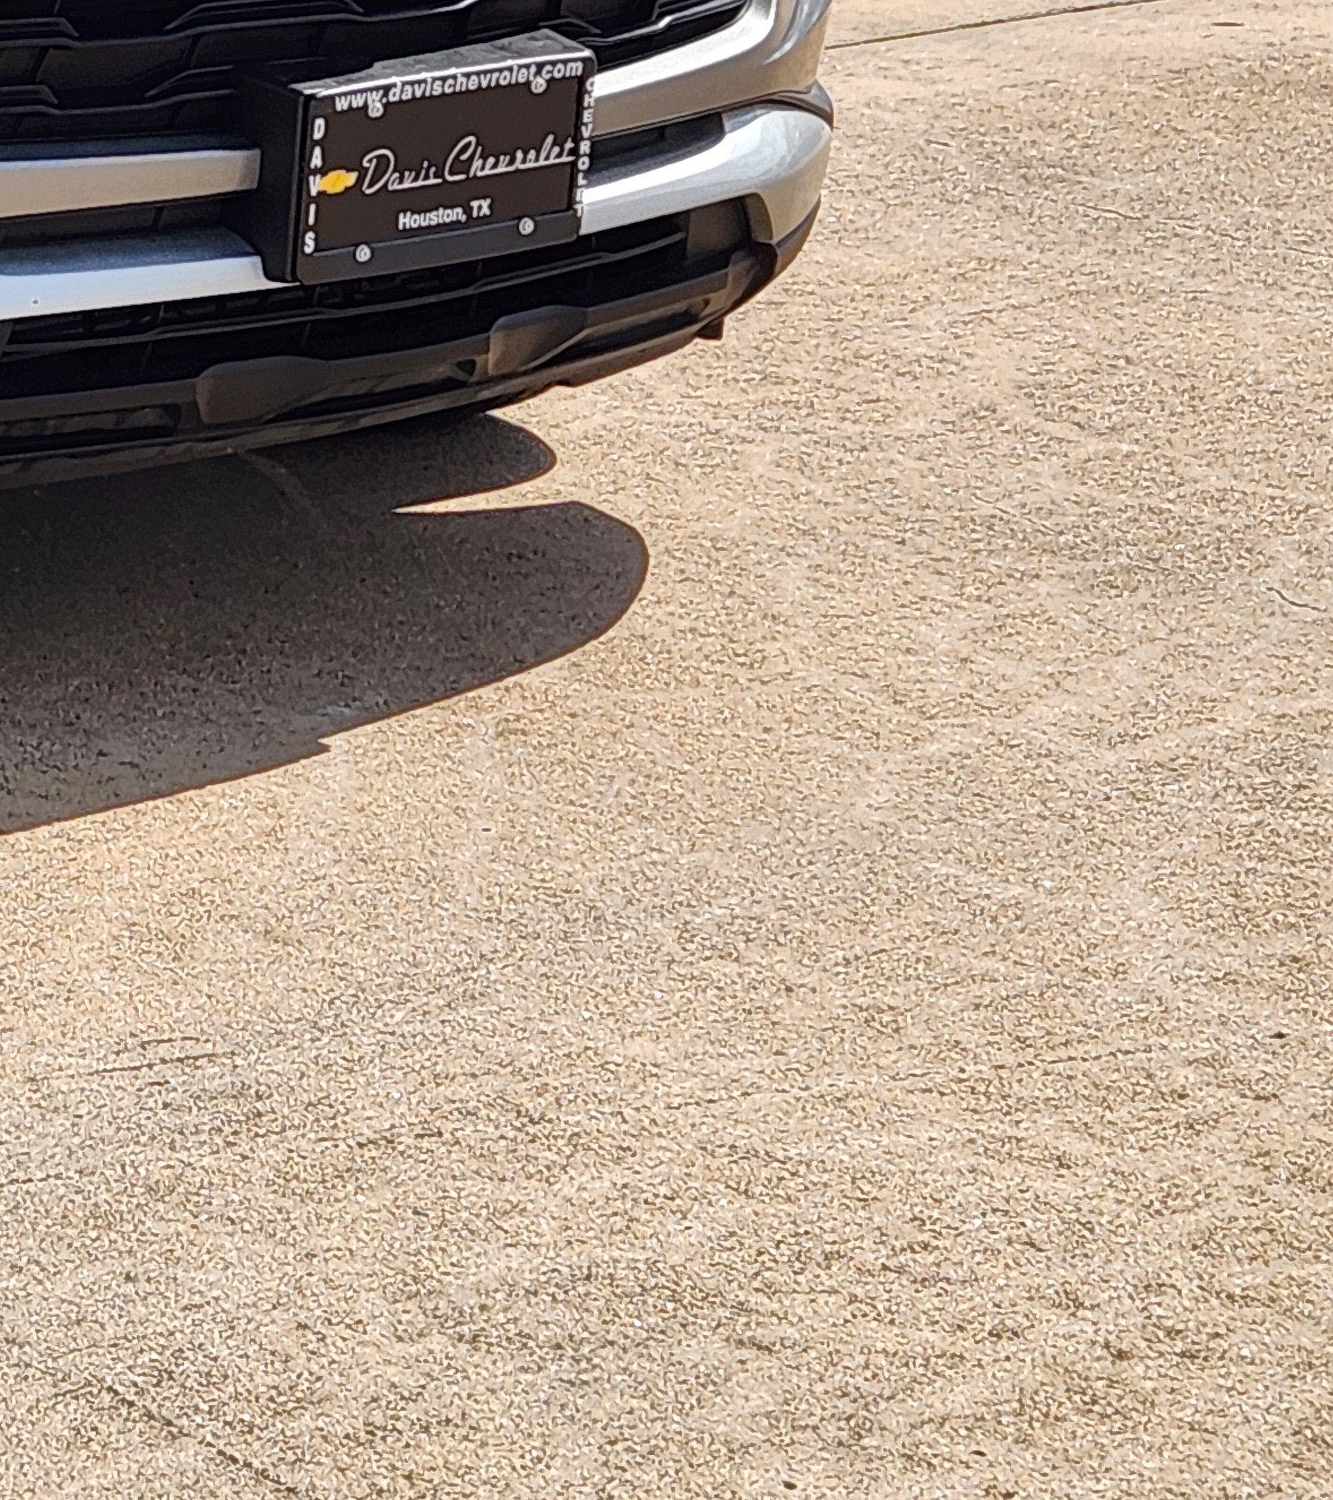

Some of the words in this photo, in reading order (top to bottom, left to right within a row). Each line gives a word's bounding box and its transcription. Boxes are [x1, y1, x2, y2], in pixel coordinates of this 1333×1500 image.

[334, 60, 584, 112] www.davischevrolet.com
[303, 117, 326, 255] DAVIS
[361, 148, 443, 195] Davis
[444, 133, 576, 182] Chevrolet
[398, 206, 469, 231] Houston,
[469, 198, 493, 219] TX
